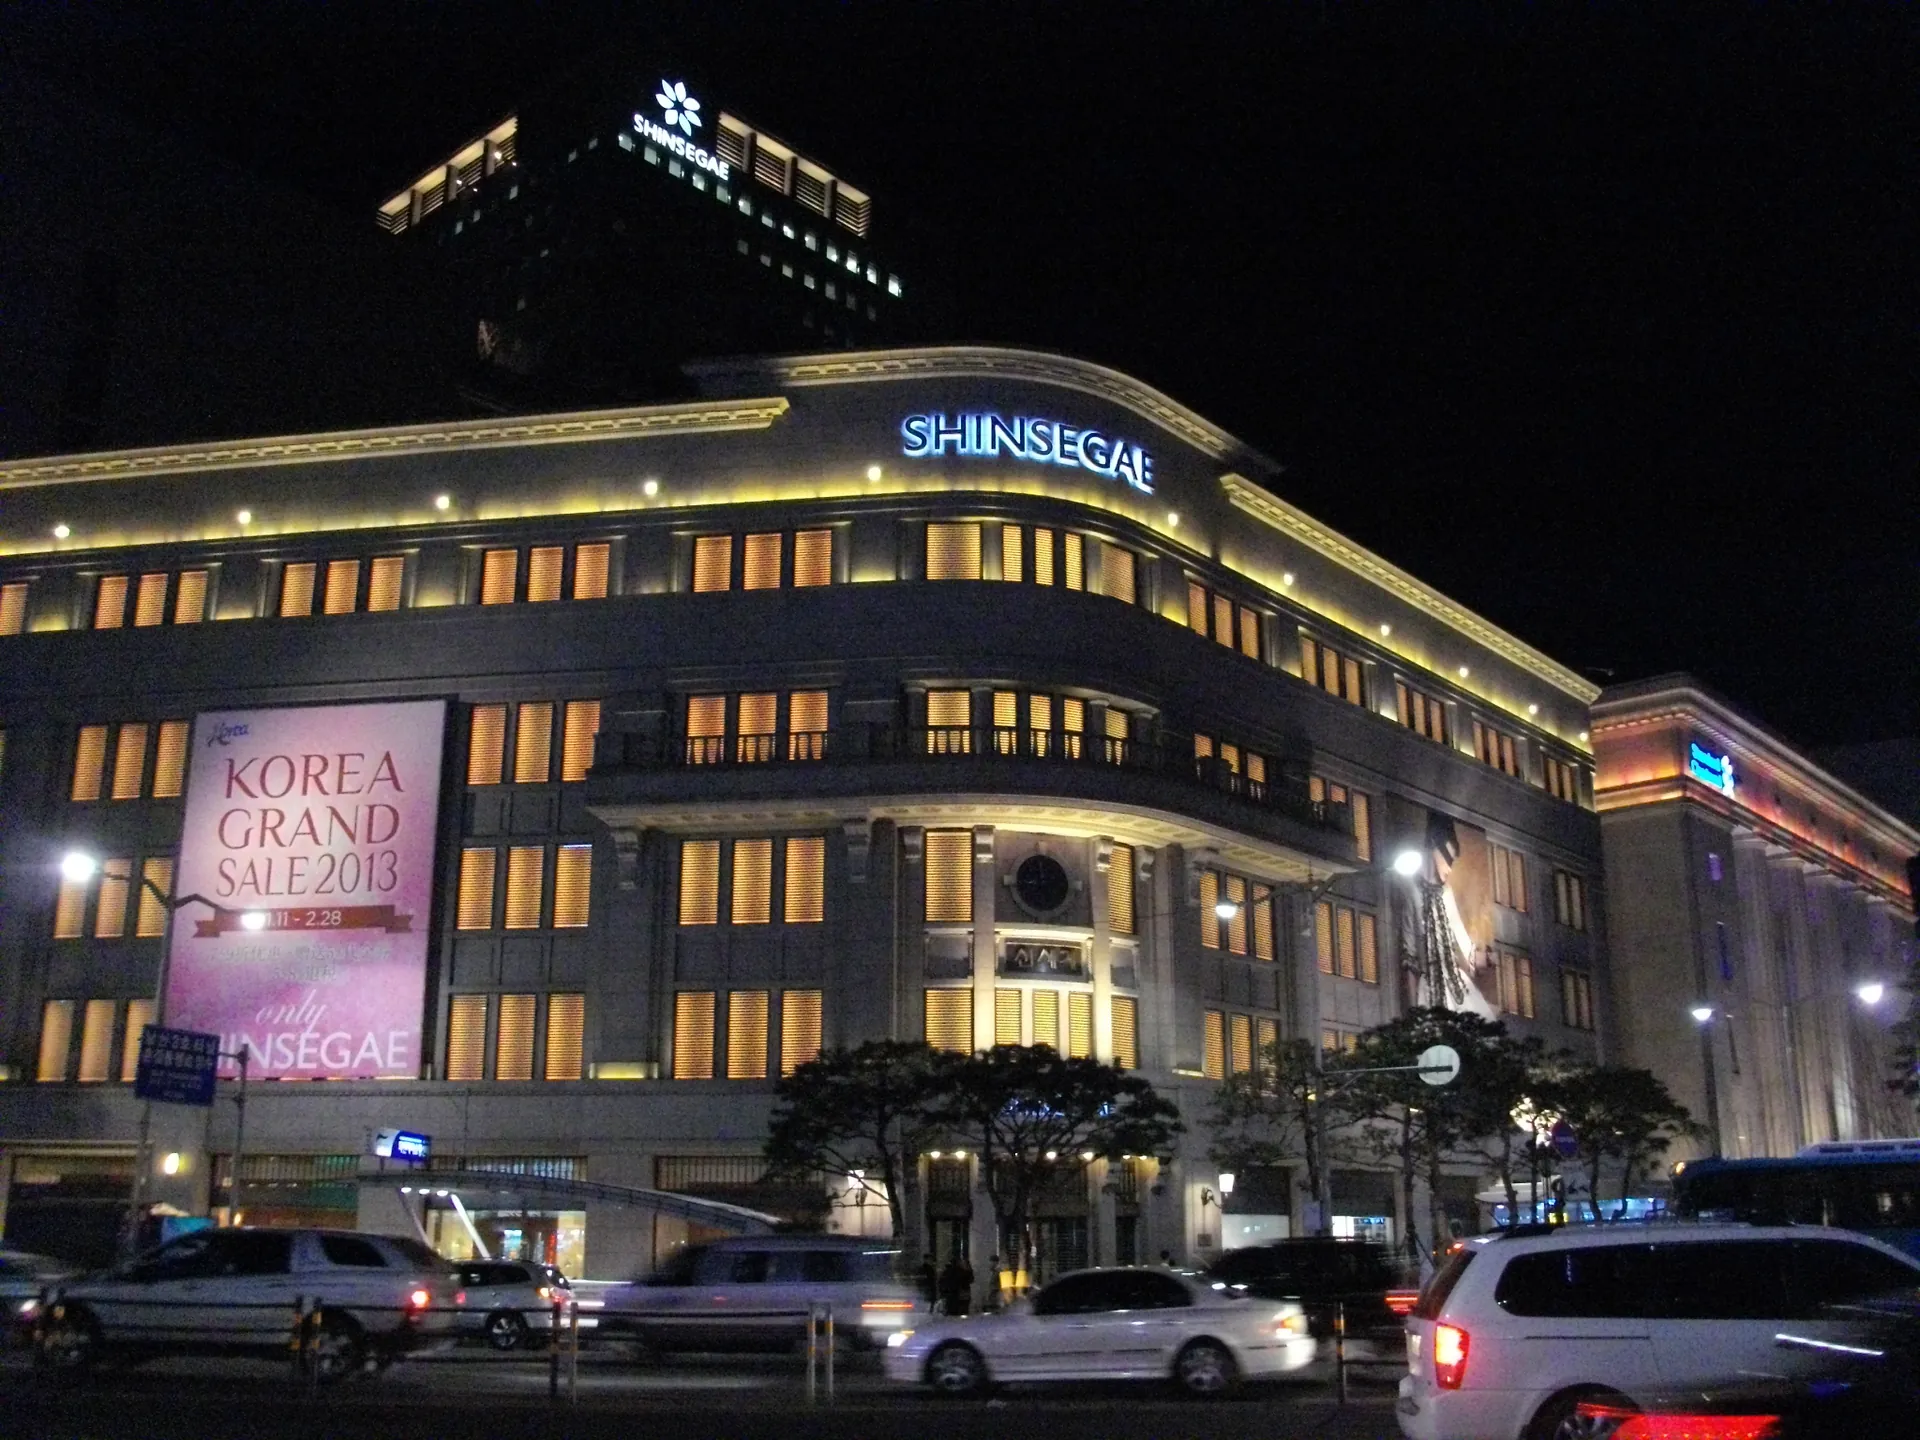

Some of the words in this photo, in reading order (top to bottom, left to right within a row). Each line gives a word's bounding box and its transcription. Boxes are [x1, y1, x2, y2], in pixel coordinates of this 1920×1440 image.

[633, 113, 729, 181] SHINSEGAE
[903, 413, 1155, 495] SHINSEGAE
[225, 750, 405, 799] KOREA
[218, 804, 400, 850] GRAND
[216, 856, 309, 897] SALE
[315, 850, 398, 893] 2013
[305, 910, 341, 926] 2.28
[255, 989, 327, 1038] only
[217, 1032, 409, 1069] INSEGAE
